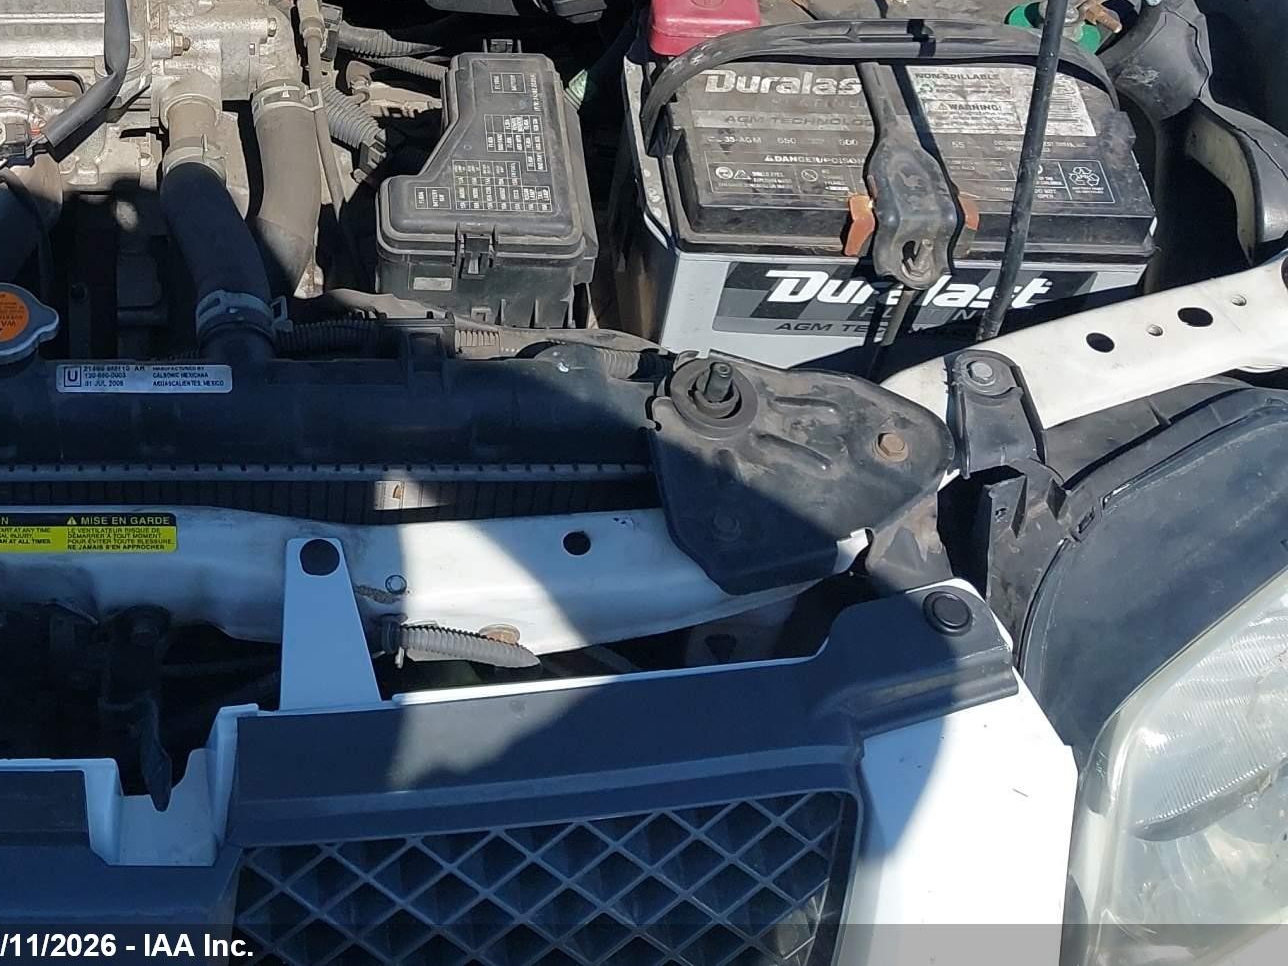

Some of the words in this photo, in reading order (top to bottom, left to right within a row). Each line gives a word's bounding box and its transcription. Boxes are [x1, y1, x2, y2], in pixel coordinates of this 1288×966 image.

[699, 69, 862, 96] Duralas
[775, 322, 833, 333] AGM
[80, 516, 108, 525] MISE
[111, 516, 126, 525] EN
[130, 516, 170, 525] GARDE
